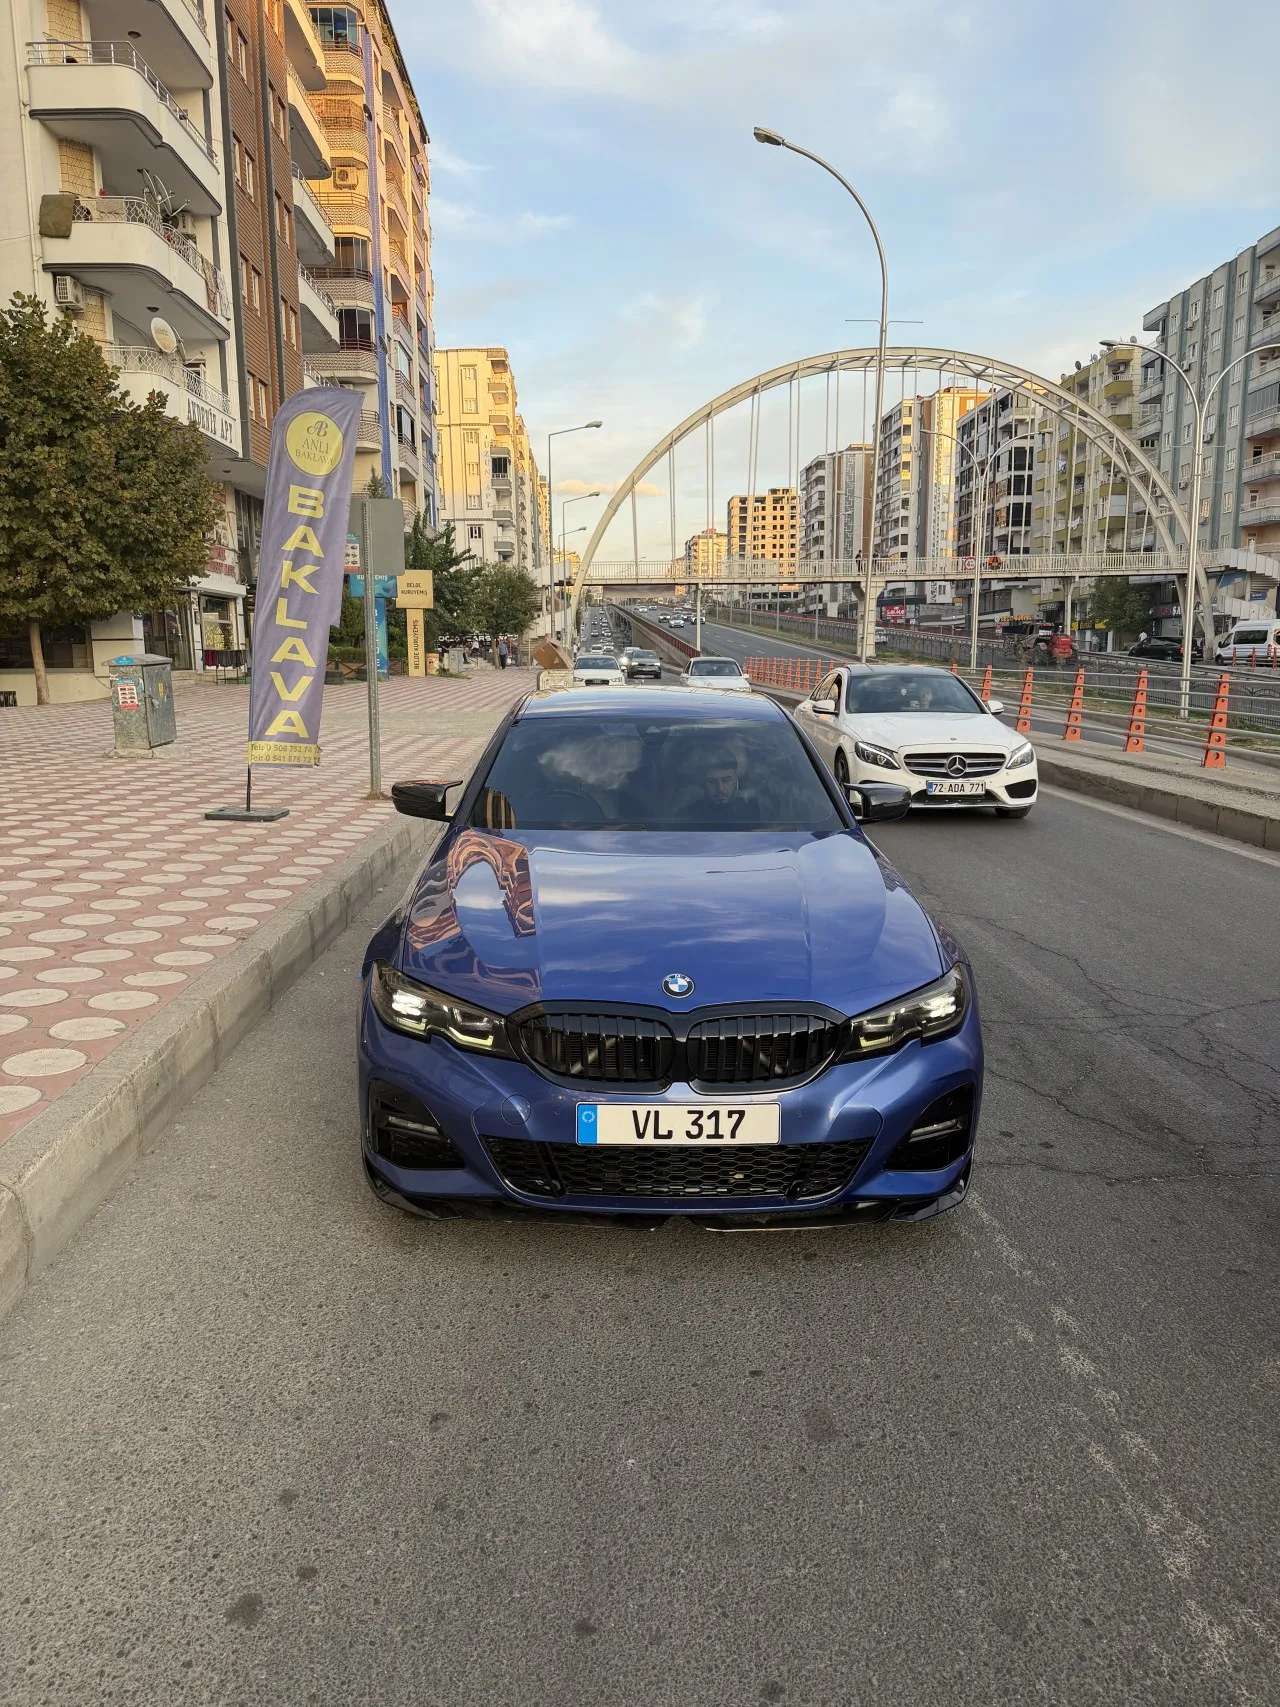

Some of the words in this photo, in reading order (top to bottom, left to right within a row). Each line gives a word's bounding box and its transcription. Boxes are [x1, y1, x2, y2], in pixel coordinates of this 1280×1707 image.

[301, 436, 329, 455] ANLI
[295, 448, 334, 466] BAKLAVA
[264, 484, 325, 739] BAKLAVA
[251, 743, 264, 751] Tel:
[273, 744, 288, 752] 506
[289, 745, 302, 753] 752
[265, 754, 271, 762] 0
[933, 783, 944, 793] 72
[947, 783, 965, 793] ADA
[969, 783, 984, 793] 771
[632, 1109, 673, 1140] VL
[685, 1109, 746, 1140] 317
